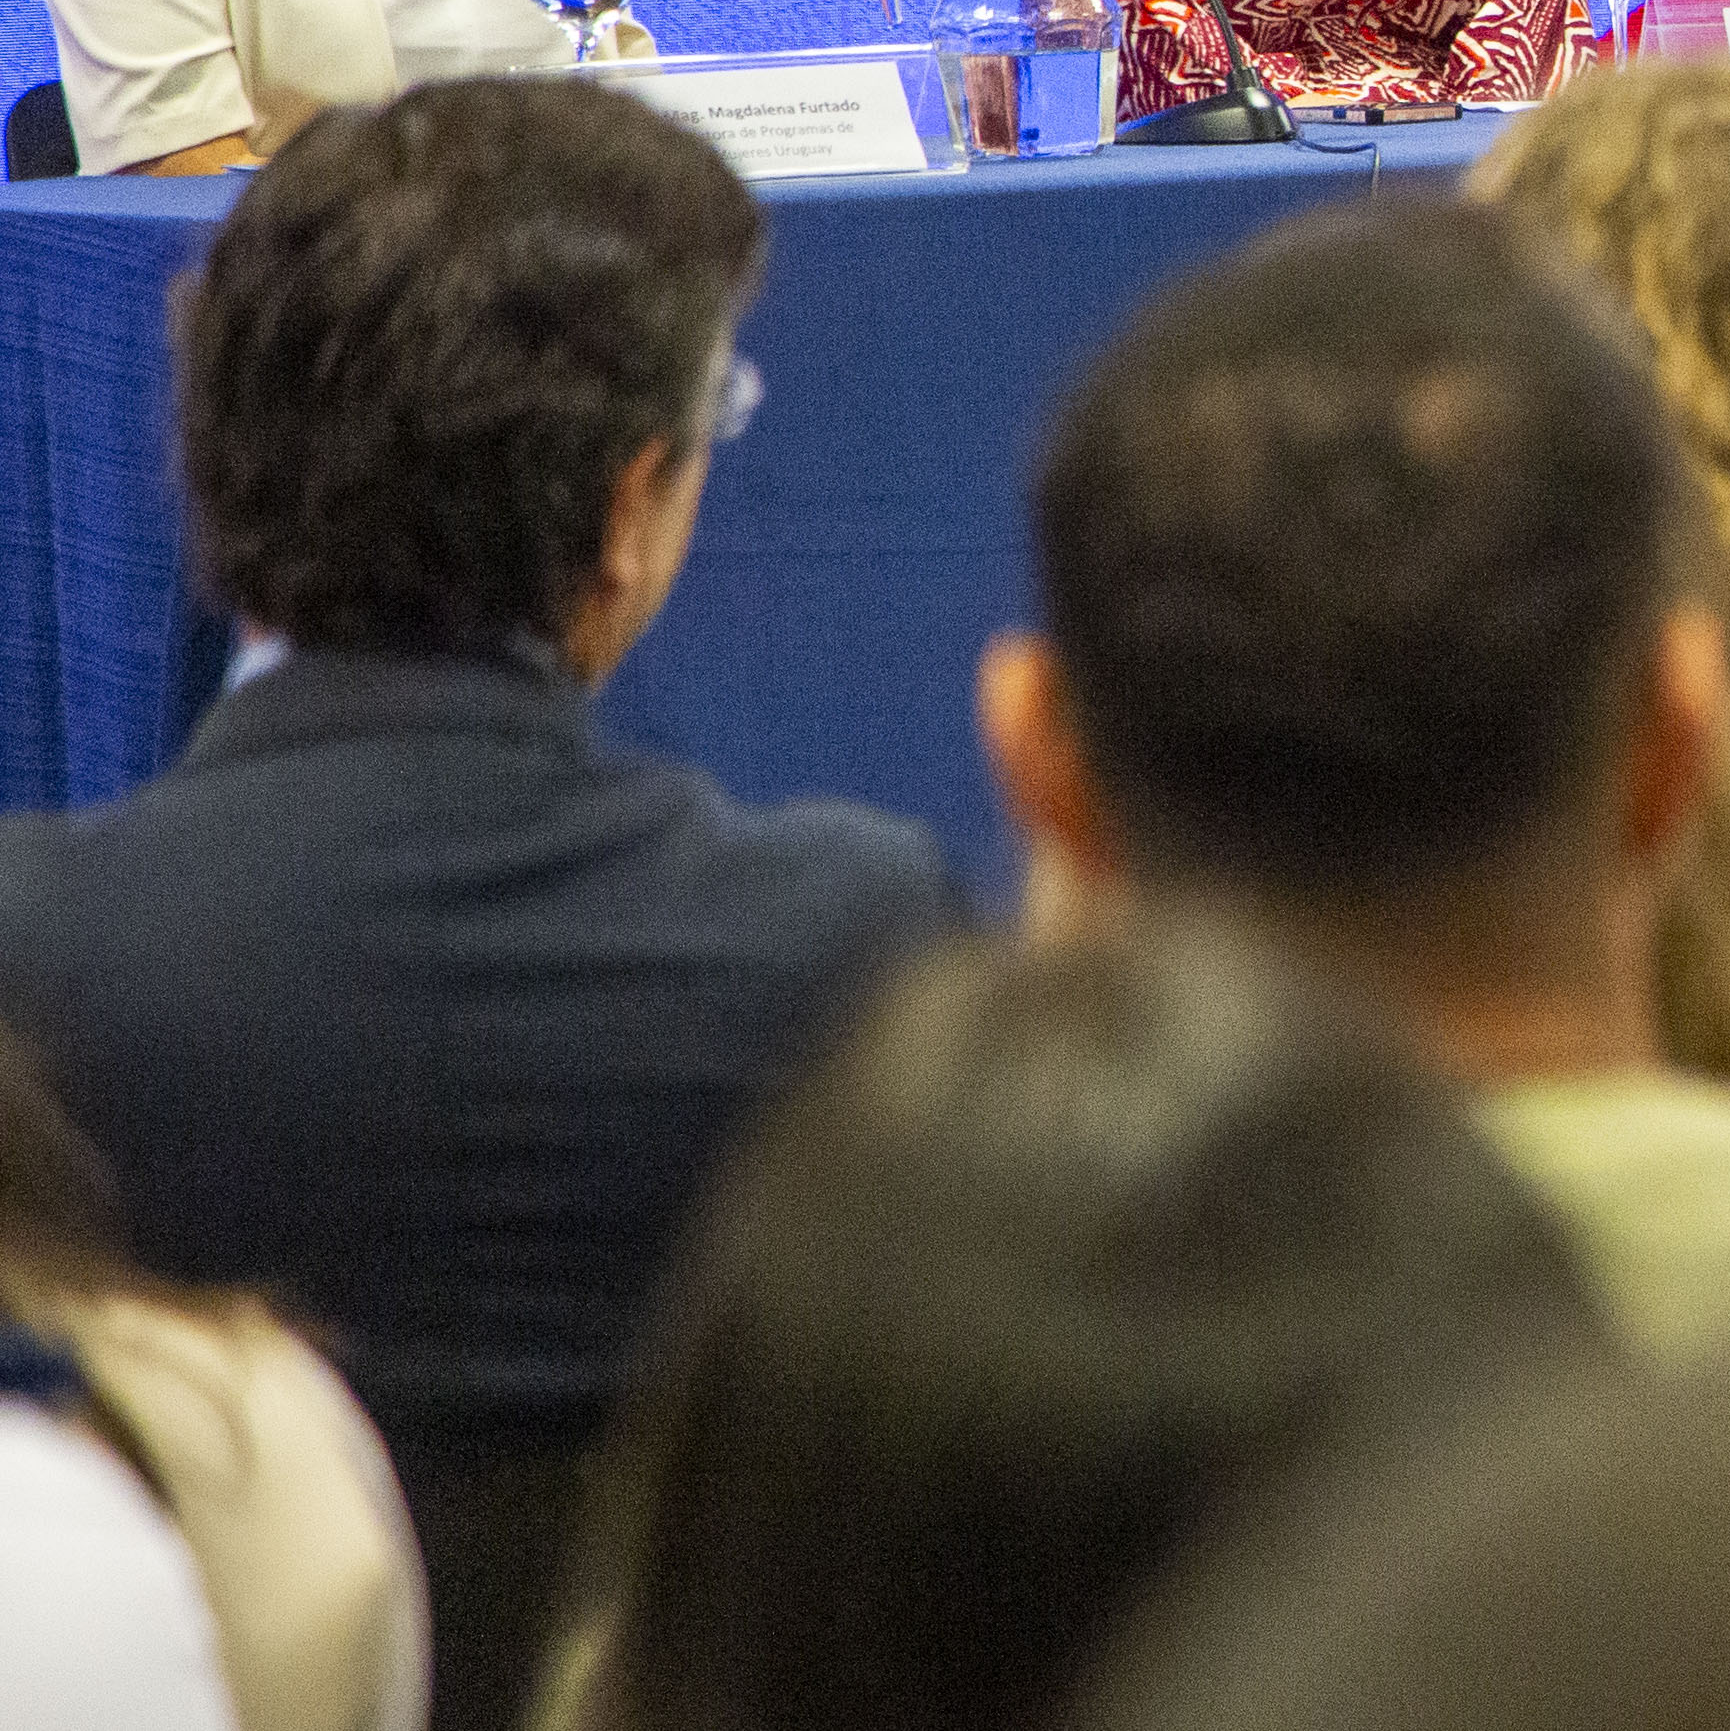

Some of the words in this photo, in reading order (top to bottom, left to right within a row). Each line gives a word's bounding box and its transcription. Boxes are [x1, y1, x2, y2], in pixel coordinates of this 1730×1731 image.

[708, 102, 796, 120] Magdalena
[799, 99, 861, 115] Furtado
[739, 125, 757, 139] de
[760, 123, 834, 141] Programas
[837, 120, 855, 133] de
